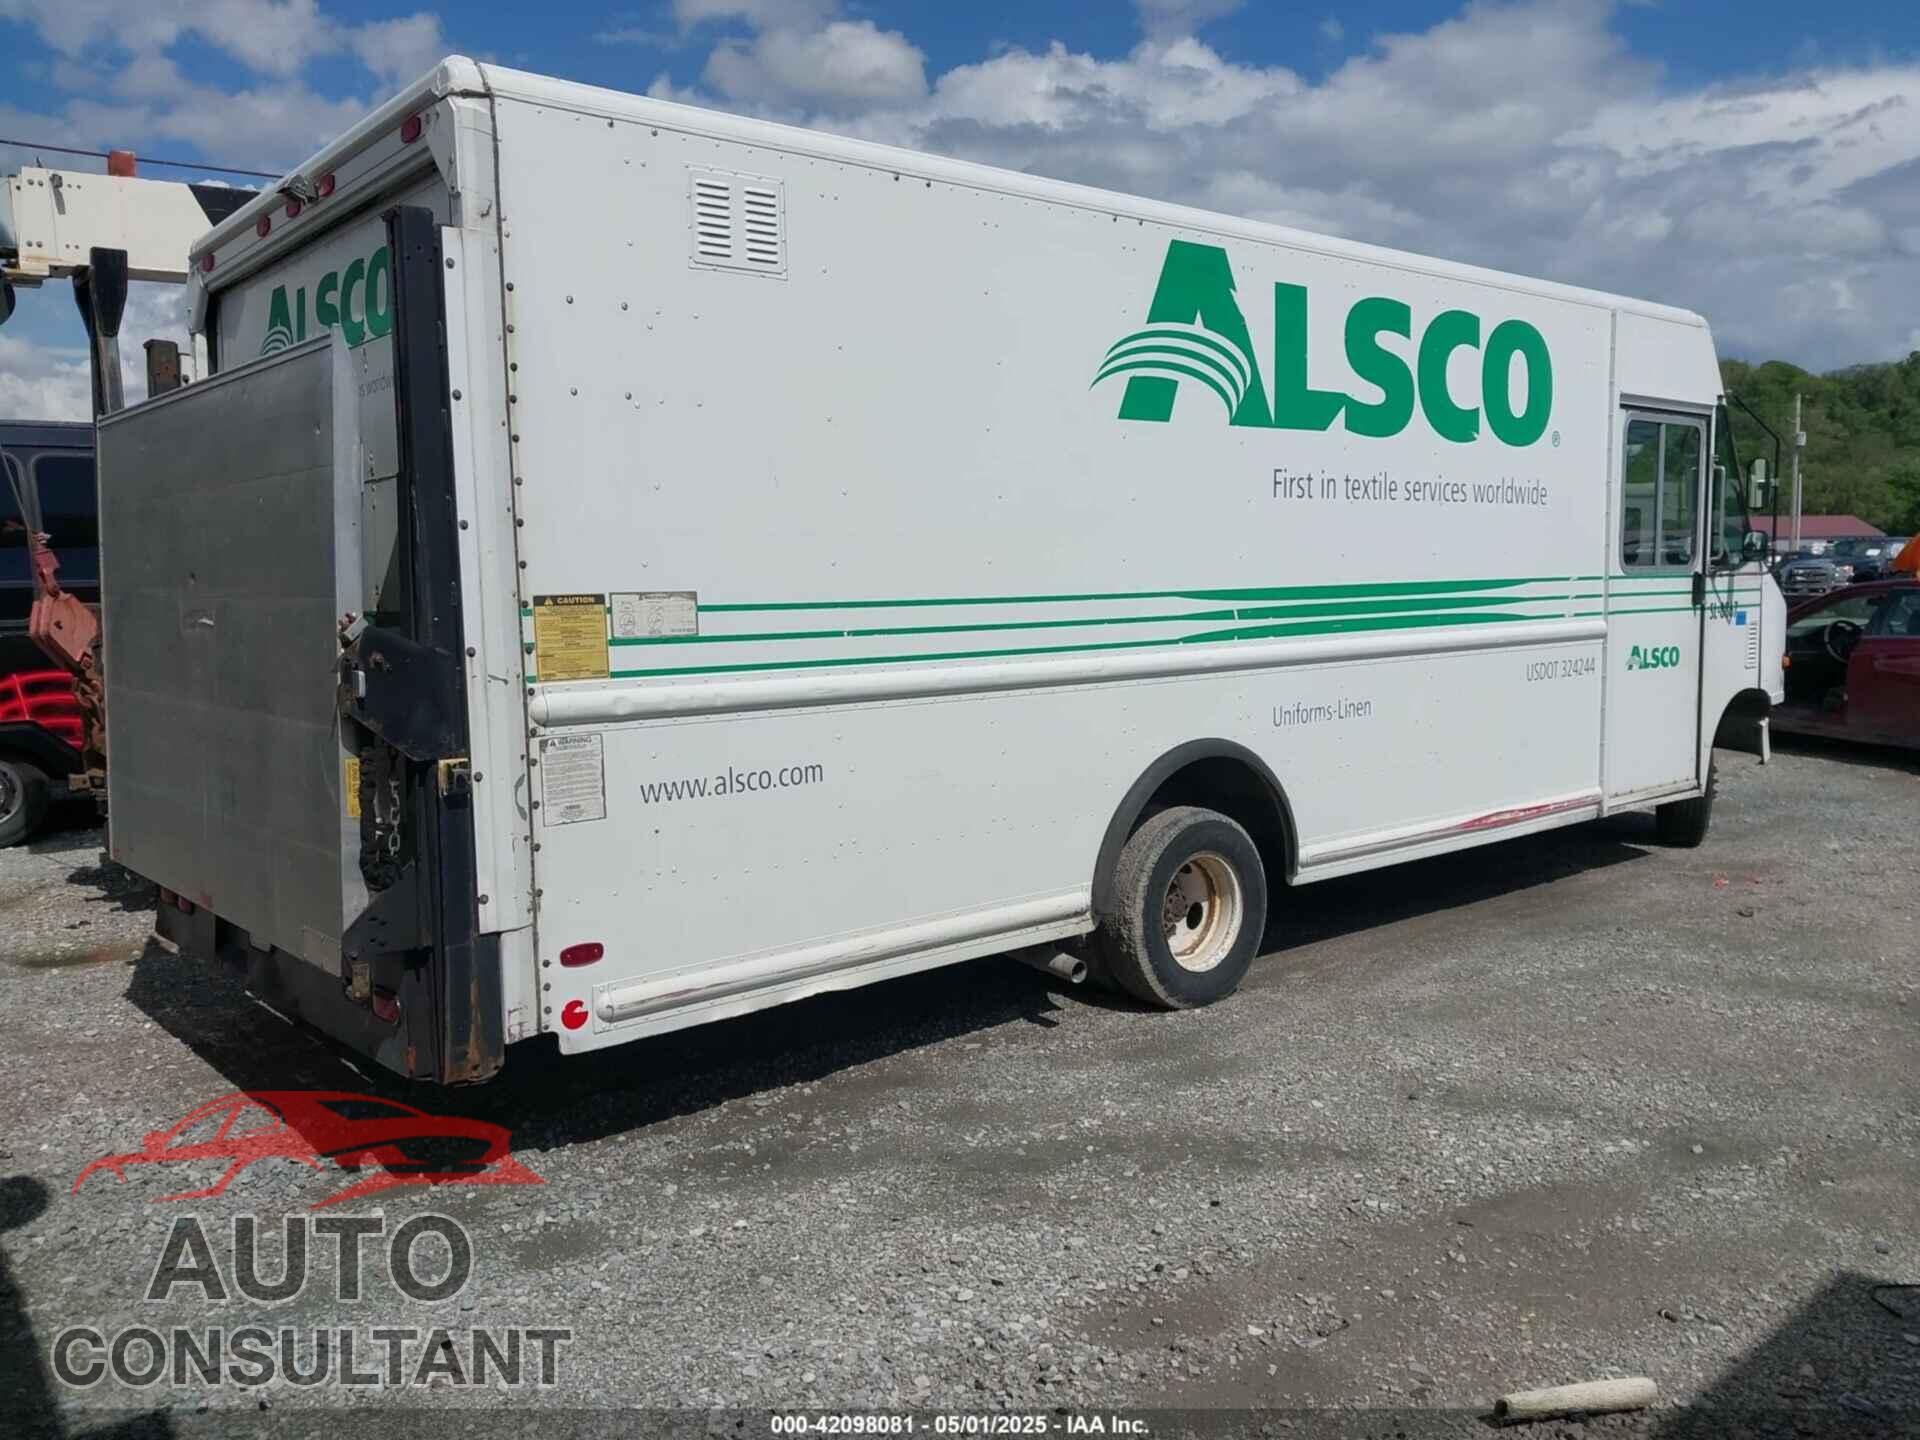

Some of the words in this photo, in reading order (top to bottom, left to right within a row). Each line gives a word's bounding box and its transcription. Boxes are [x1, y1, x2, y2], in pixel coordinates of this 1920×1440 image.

[1089, 239, 1553, 447] ALSCO
[1272, 468, 1313, 499] First
[1320, 469, 1337, 500] in
[1343, 471, 1399, 501] textile
[1404, 475, 1468, 503] services
[1472, 477, 1549, 505] worldwide
[556, 596, 595, 605] CAUTION
[1526, 661, 1560, 682] USDOT
[1561, 657, 1596, 678] 324244
[1626, 645, 1681, 671] ALSCO
[1272, 697, 1372, 728] Uniforms-Linen
[639, 763, 824, 804] www.alsco.com
